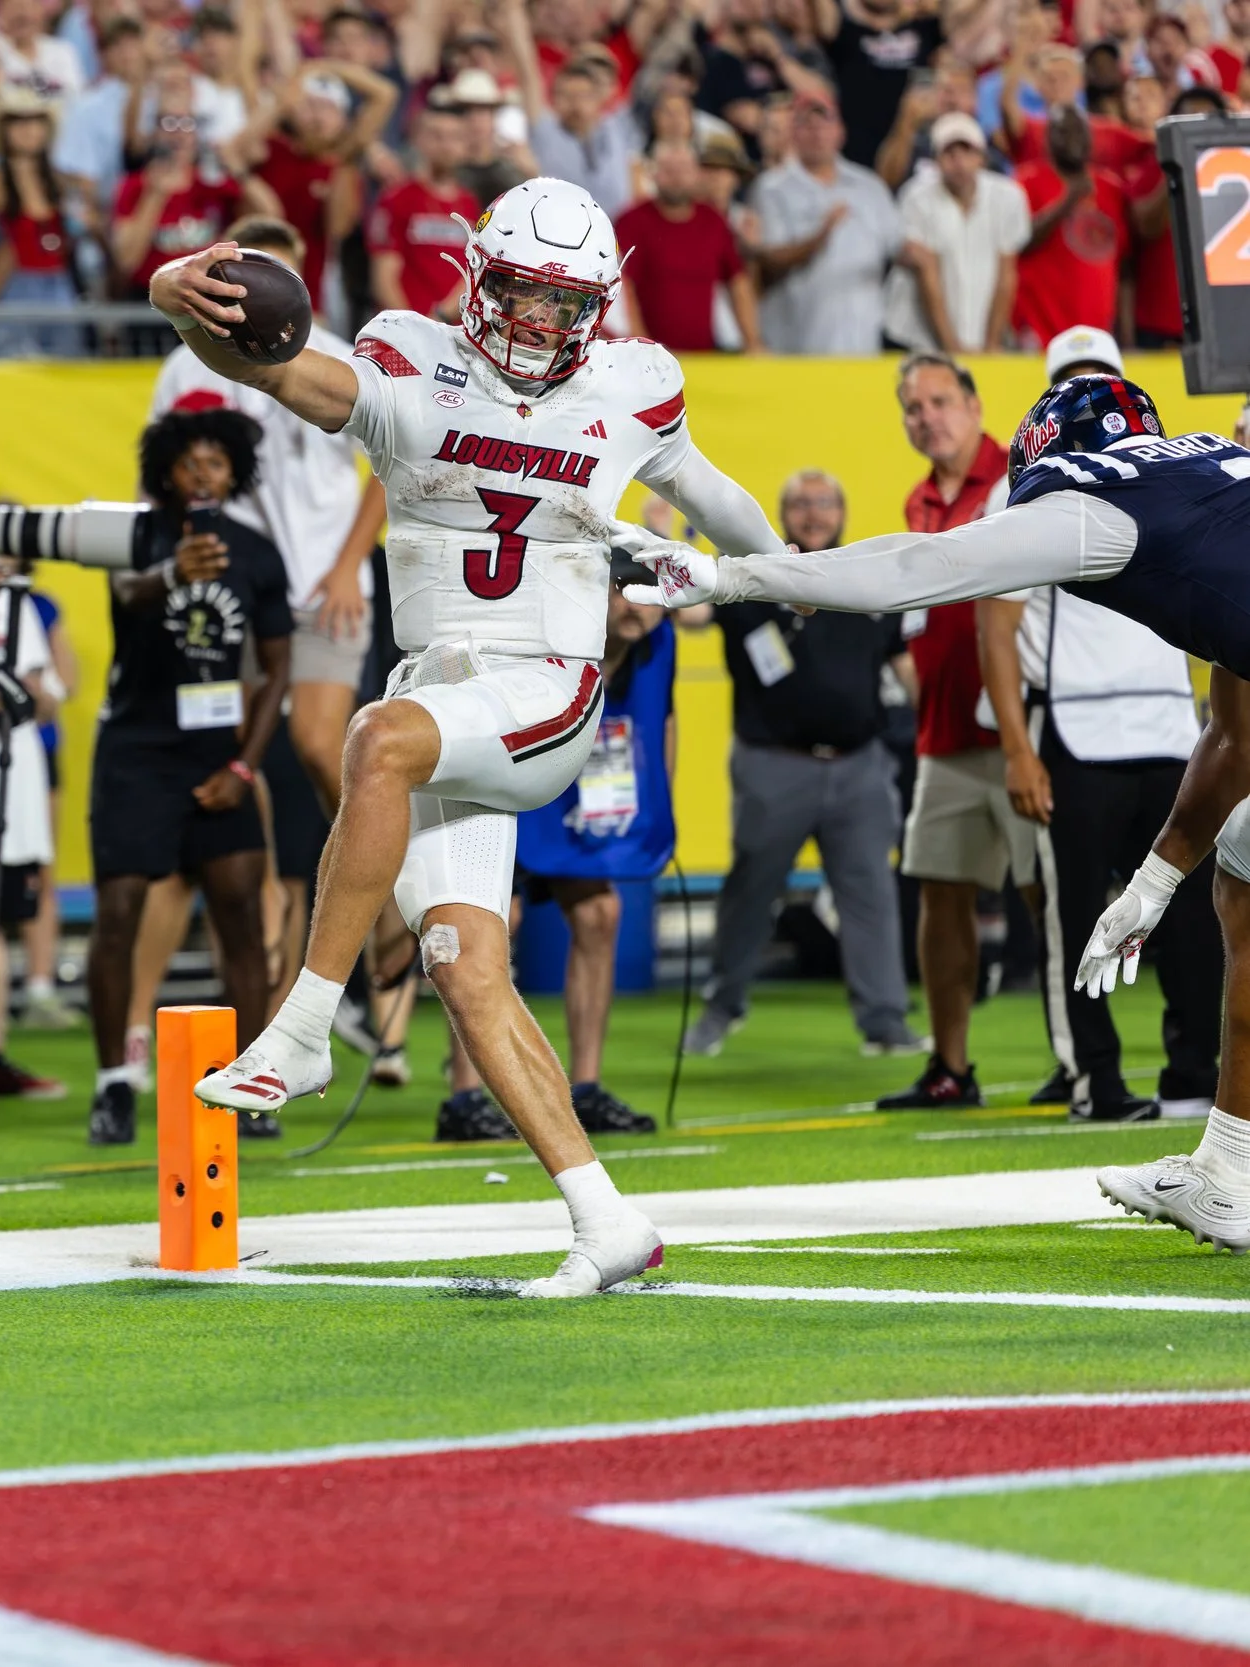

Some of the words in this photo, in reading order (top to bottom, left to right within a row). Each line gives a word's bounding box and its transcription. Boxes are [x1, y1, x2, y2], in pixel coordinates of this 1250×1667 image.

[1196, 146, 1250, 286] 2
[539, 261, 569, 274] ACC
[436, 393, 461, 405] ACC
[438, 367, 466, 382] L&N
[431, 429, 600, 489] LOUISVILLE
[1019, 416, 1060, 467] Miss
[462, 486, 542, 600] 3
